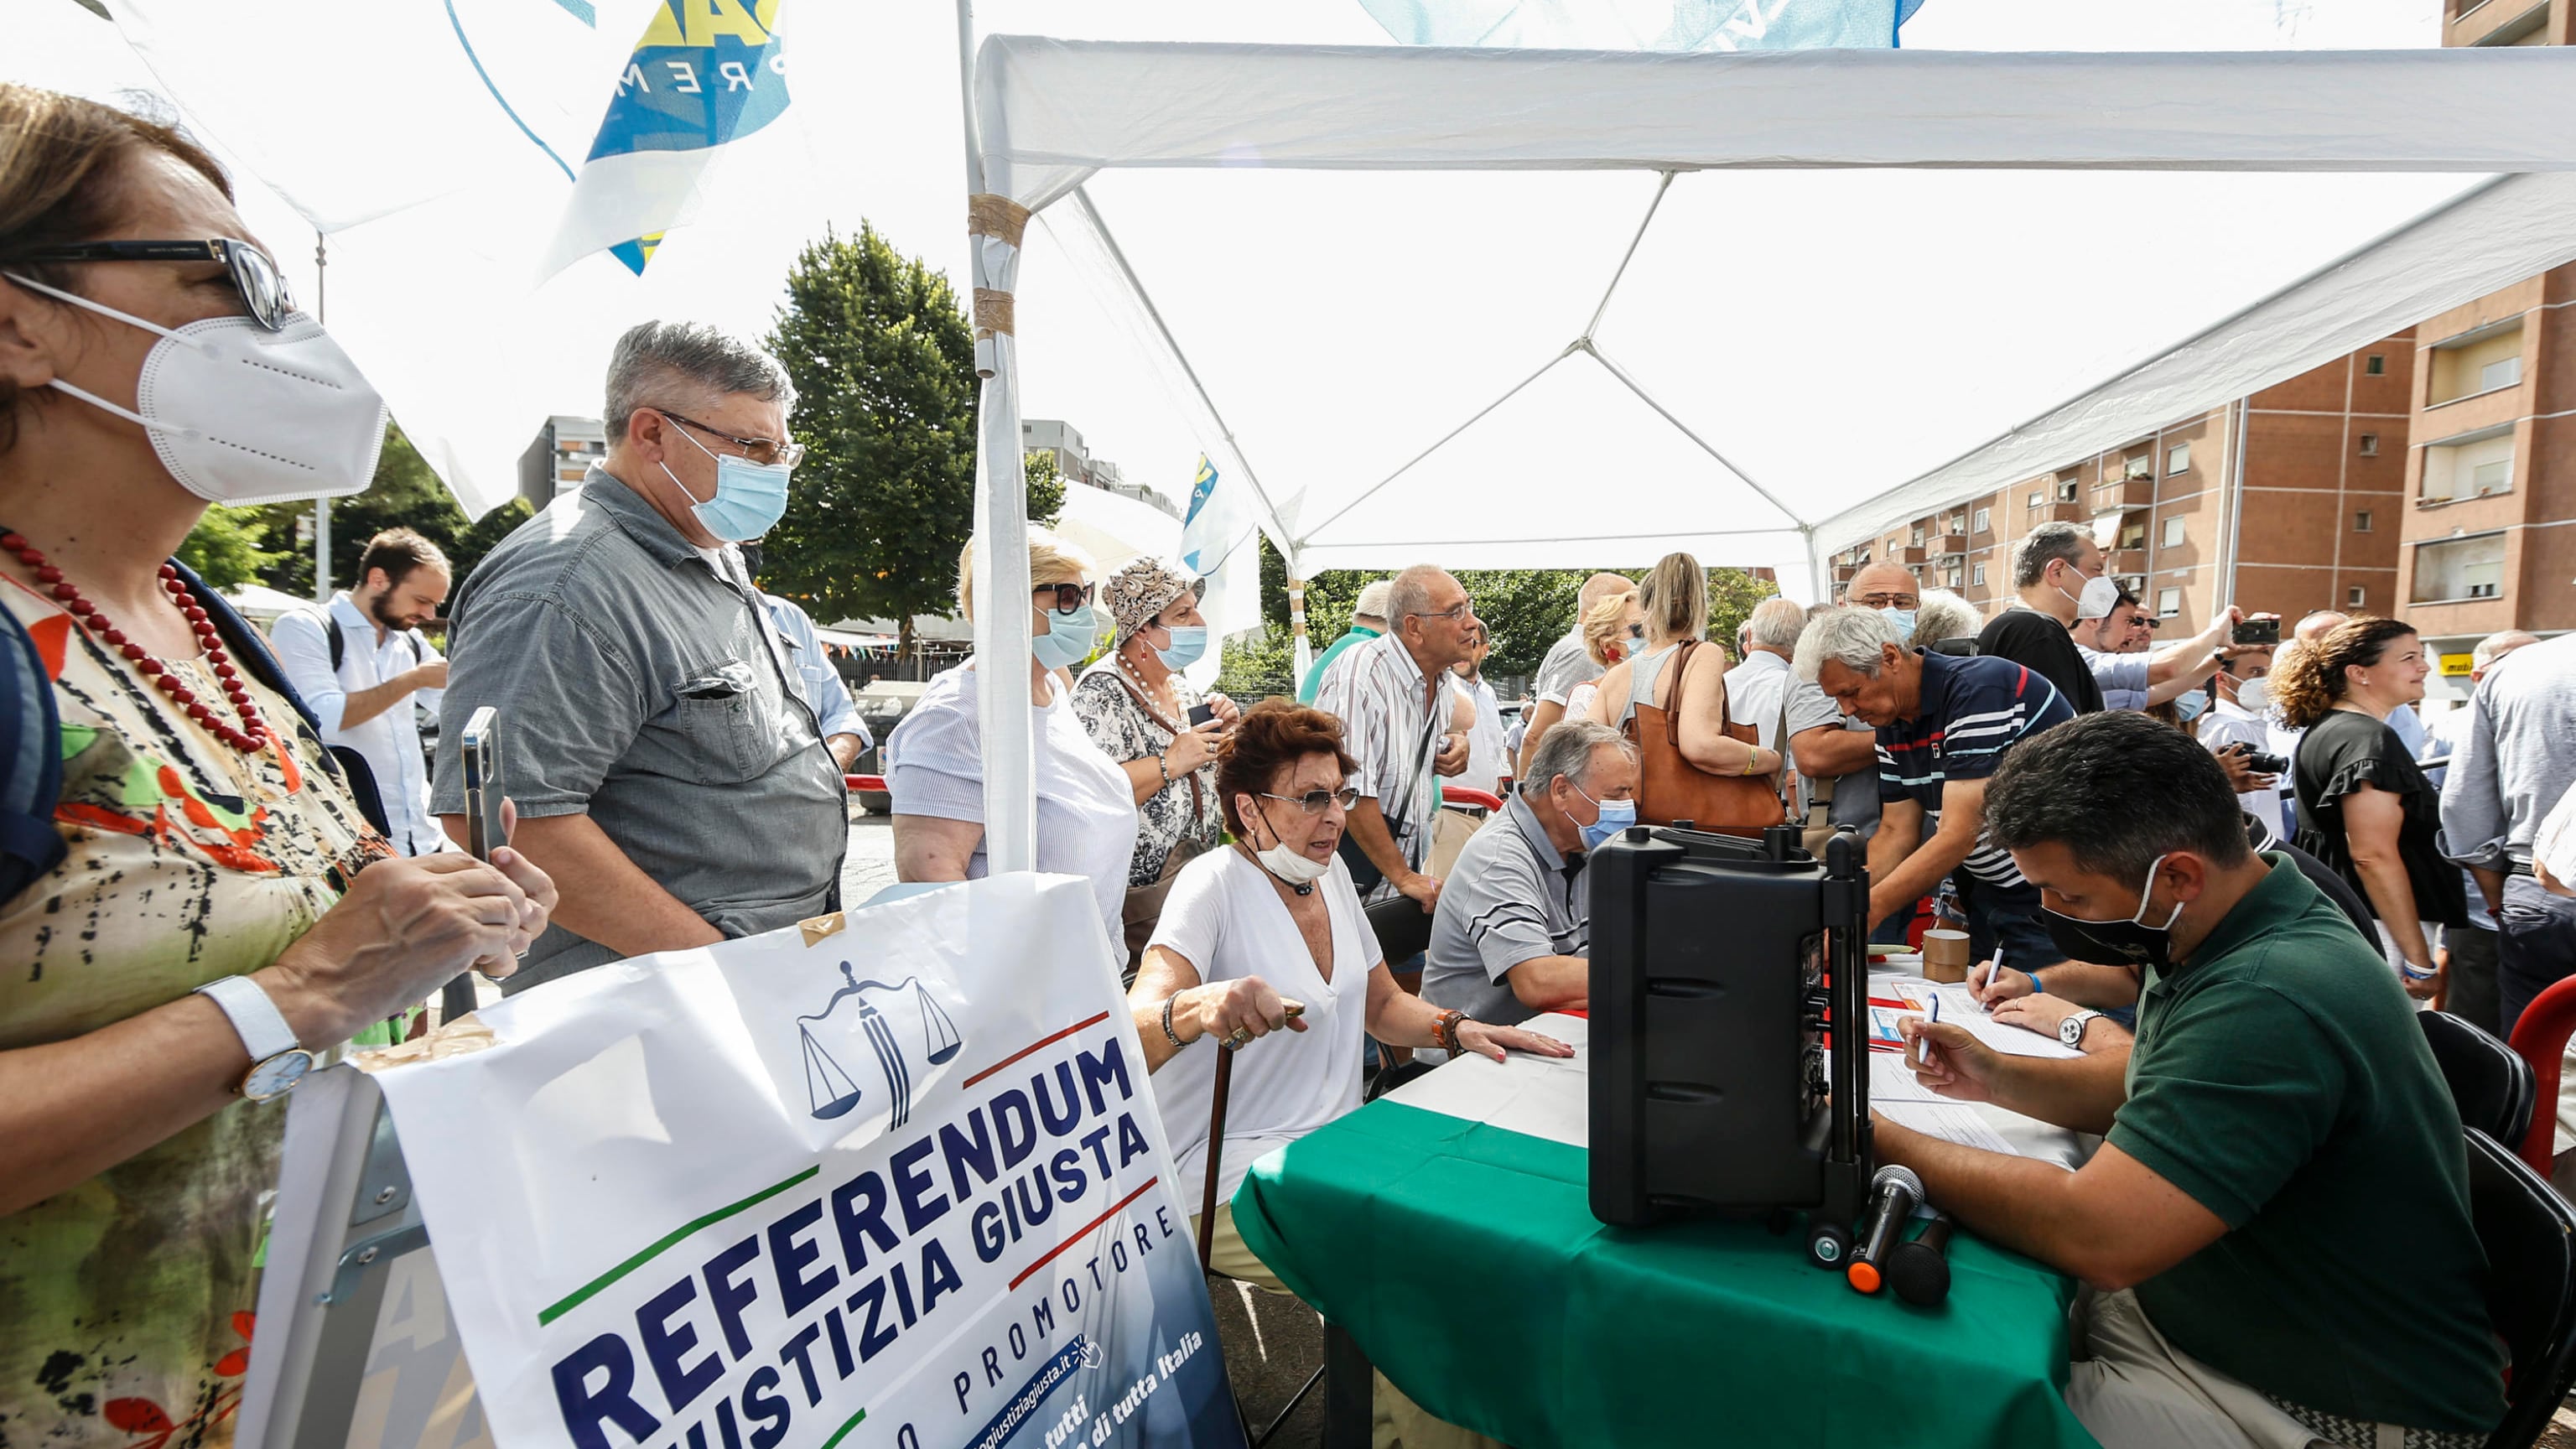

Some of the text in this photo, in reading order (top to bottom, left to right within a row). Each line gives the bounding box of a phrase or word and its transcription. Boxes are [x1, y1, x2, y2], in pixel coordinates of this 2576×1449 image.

[551, 1036, 1135, 1449] REFERENDUM
[973, 1112, 1149, 1264] GIUSTA
[953, 1204, 1174, 1415] PROMOTORE
[1045, 1394, 1089, 1449] tutti
[1092, 1330, 1202, 1449] di tutta Italia
